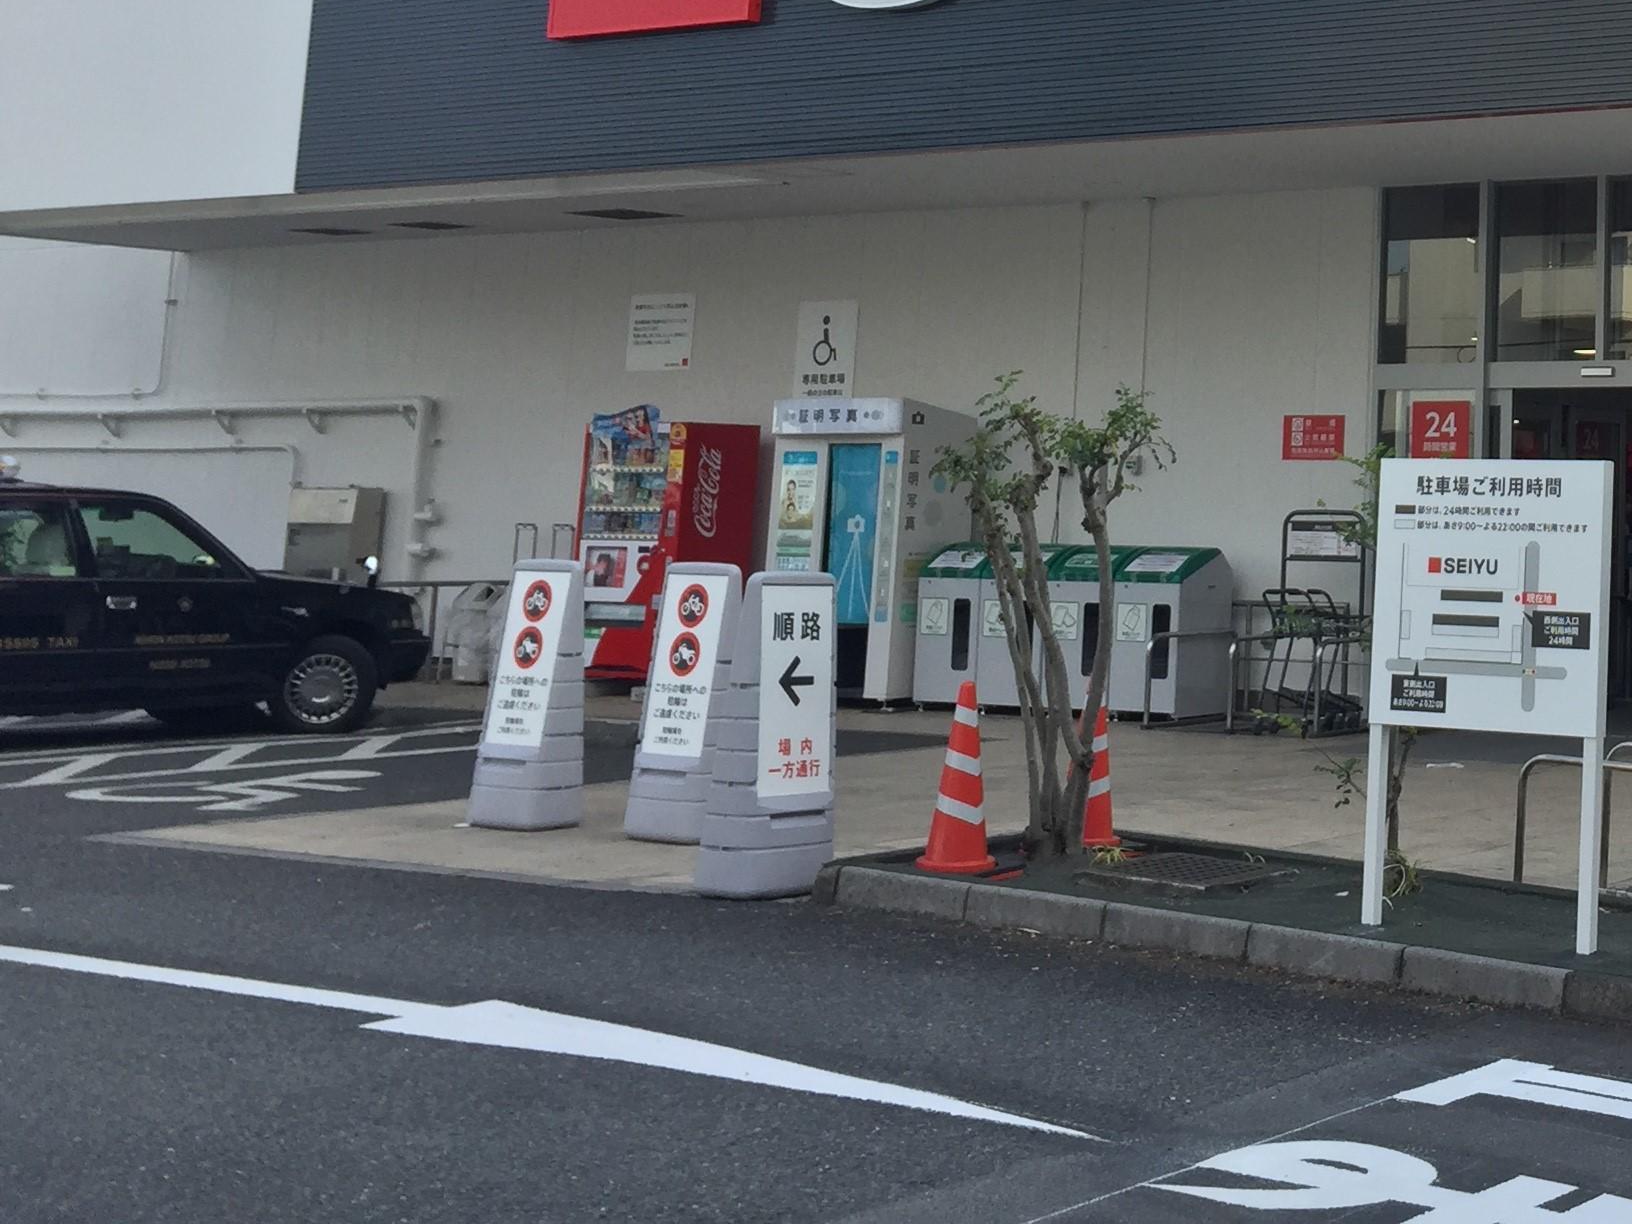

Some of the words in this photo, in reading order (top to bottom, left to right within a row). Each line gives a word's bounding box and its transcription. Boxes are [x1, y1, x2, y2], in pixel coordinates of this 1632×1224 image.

[798, 408, 859, 424] 証明写真
[1424, 410, 1458, 438] 24
[904, 449, 921, 531] 証明写真
[1416, 475, 1562, 498] 駐車場ご利用時間
[1443, 557, 1499, 575] SEIYU
[1526, 592, 1553, 604] 現在地
[773, 612, 821, 641] 順路
[1548, 635, 1573, 646] 24時間
[499, 675, 549, 687] こちらの場所への
[655, 682, 707, 695] こちらの場所への
[496, 700, 541, 711] ご遠慮ください
[653, 708, 700, 721] ご遠慮ください
[778, 737, 813, 757] 場内
[768, 759, 821, 779] 一方通行
